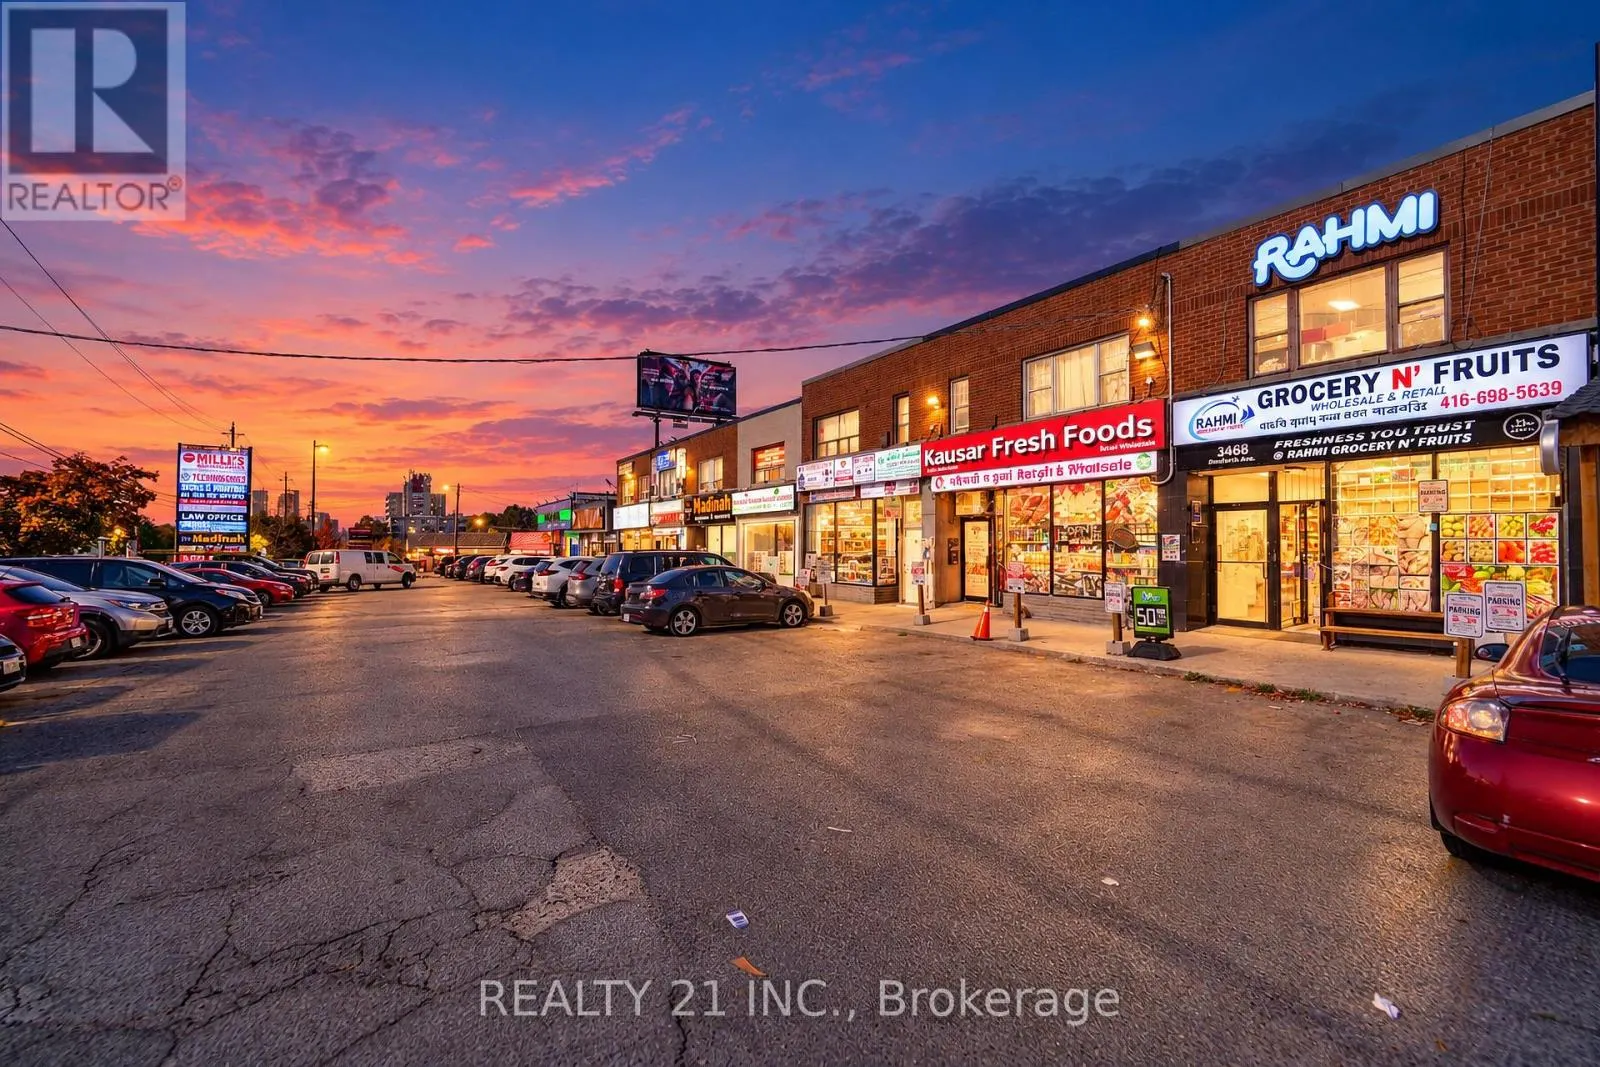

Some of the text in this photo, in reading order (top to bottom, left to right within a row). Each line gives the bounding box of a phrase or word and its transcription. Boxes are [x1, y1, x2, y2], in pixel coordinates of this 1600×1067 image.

[1252, 188, 1438, 286] RAHMI
[1257, 343, 1560, 410] GROCERY N' FRUITS
[1311, 393, 1385, 412] WHOLESALE
[1387, 391, 1397, 402] &
[1440, 380, 1563, 409] 416-698-5639
[1196, 413, 1237, 430] RAHMI
[1274, 420, 1476, 449] FRESHNESS YOU TRUST
[924, 442, 986, 467] Kausar
[992, 428, 1055, 458] Fresh
[1063, 413, 1153, 449] Foods
[1217, 443, 1249, 458] 3468
[1287, 445, 1328, 460] RAHMI
[1332, 439, 1395, 456] GROCERY
[1398, 437, 1414, 449] N'
[1418, 433, 1472, 448] FRUITS
[693, 494, 731, 514] Madinah
[1136, 607, 1156, 626] 50
